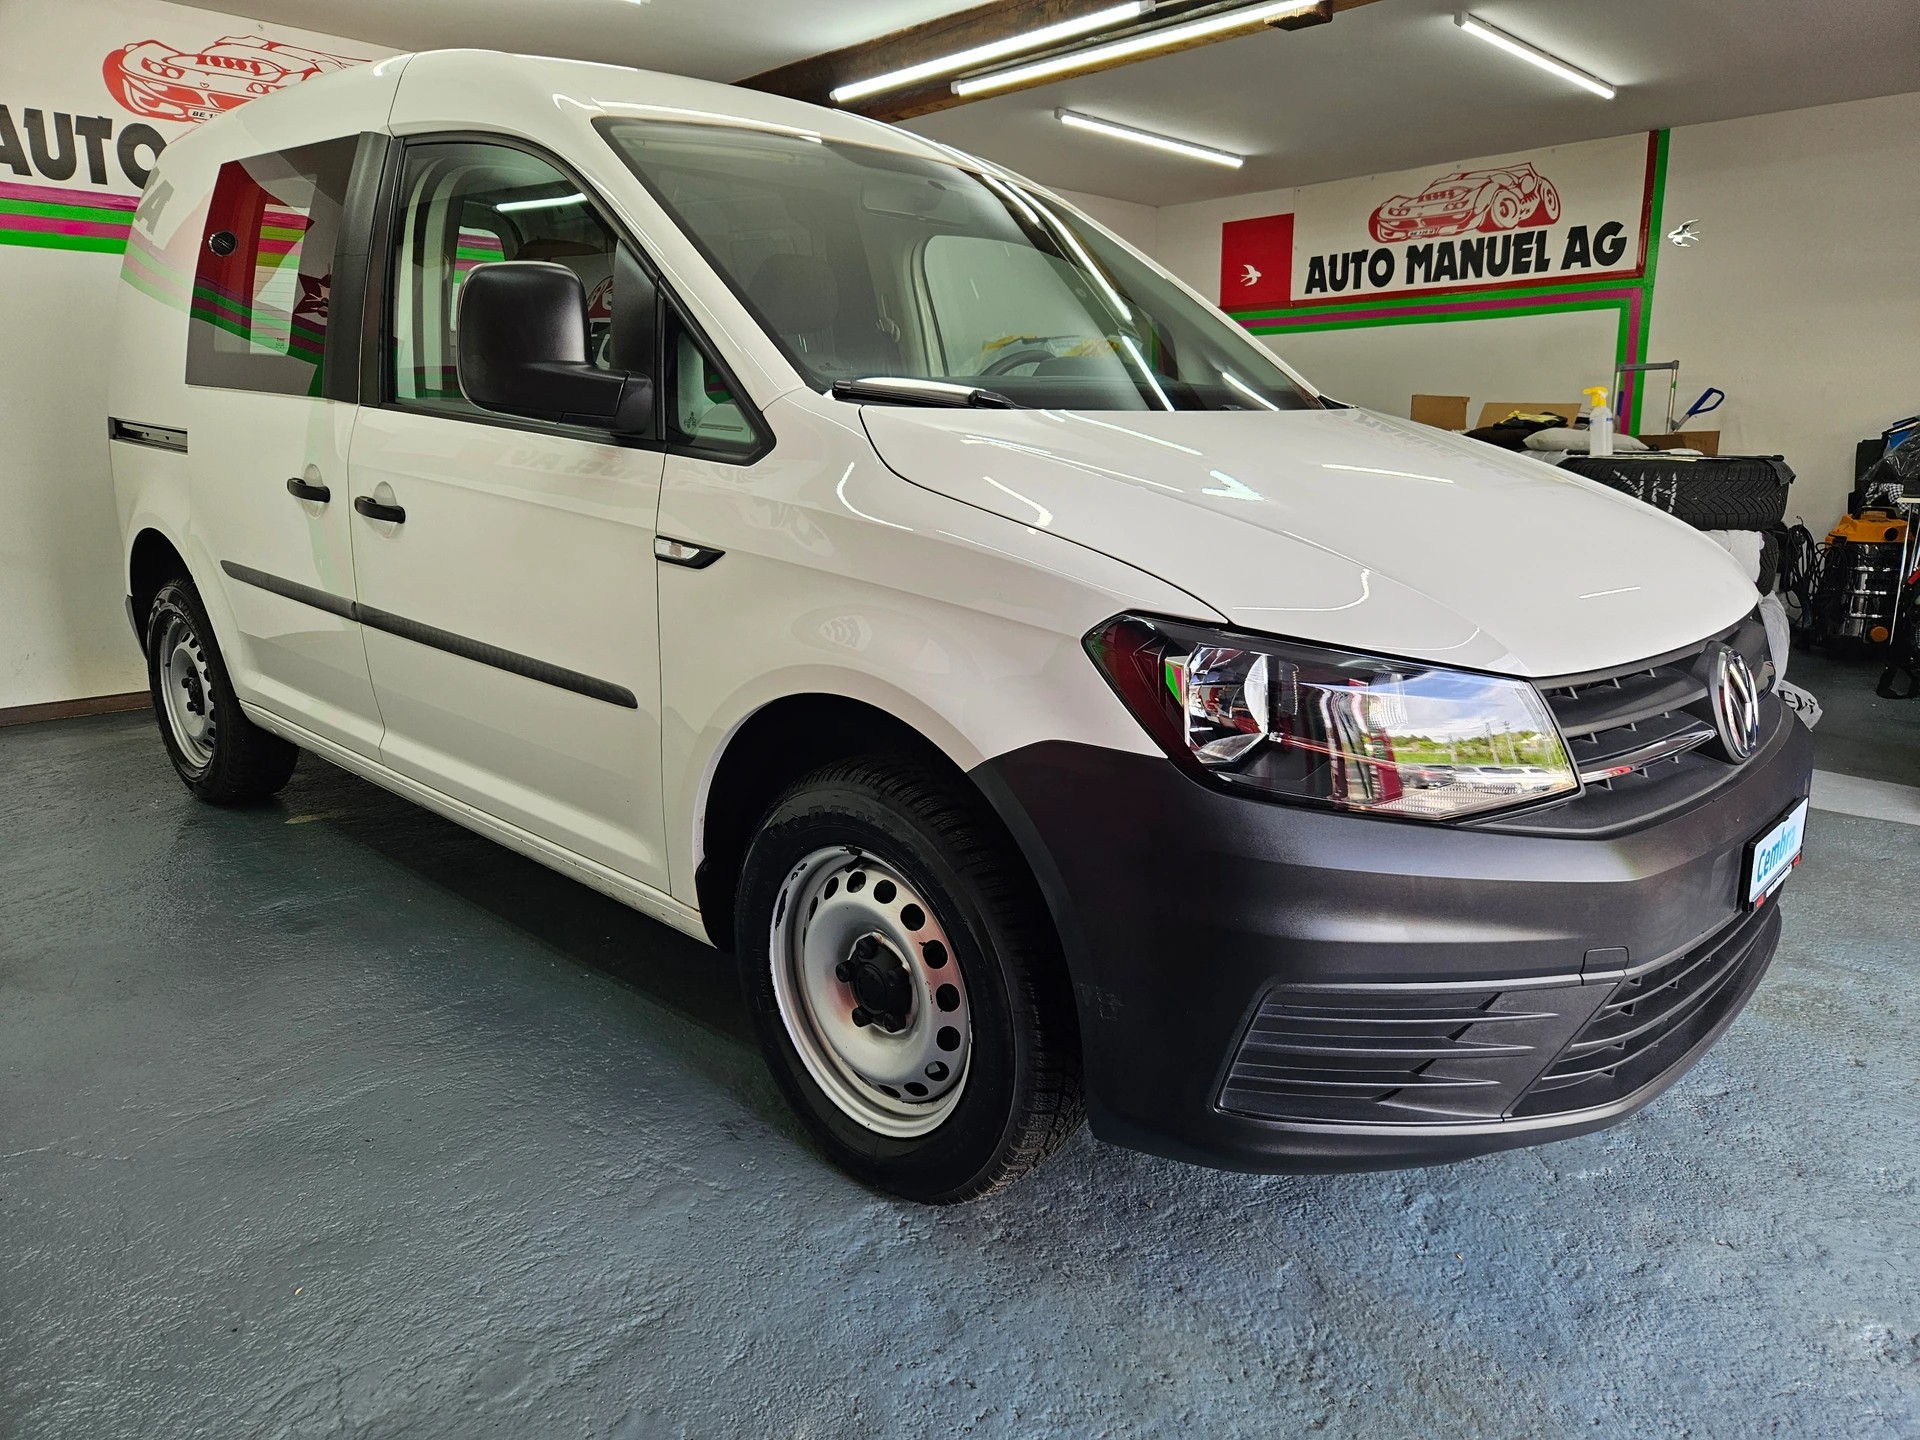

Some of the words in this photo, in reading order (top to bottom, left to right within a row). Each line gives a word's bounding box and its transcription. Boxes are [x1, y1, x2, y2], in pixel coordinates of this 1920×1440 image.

[1304, 247, 1395, 295] AUTO
[1405, 229, 1551, 285] MANUEL
[1560, 220, 1628, 270] AG
[1756, 825, 1796, 883] Cembra
